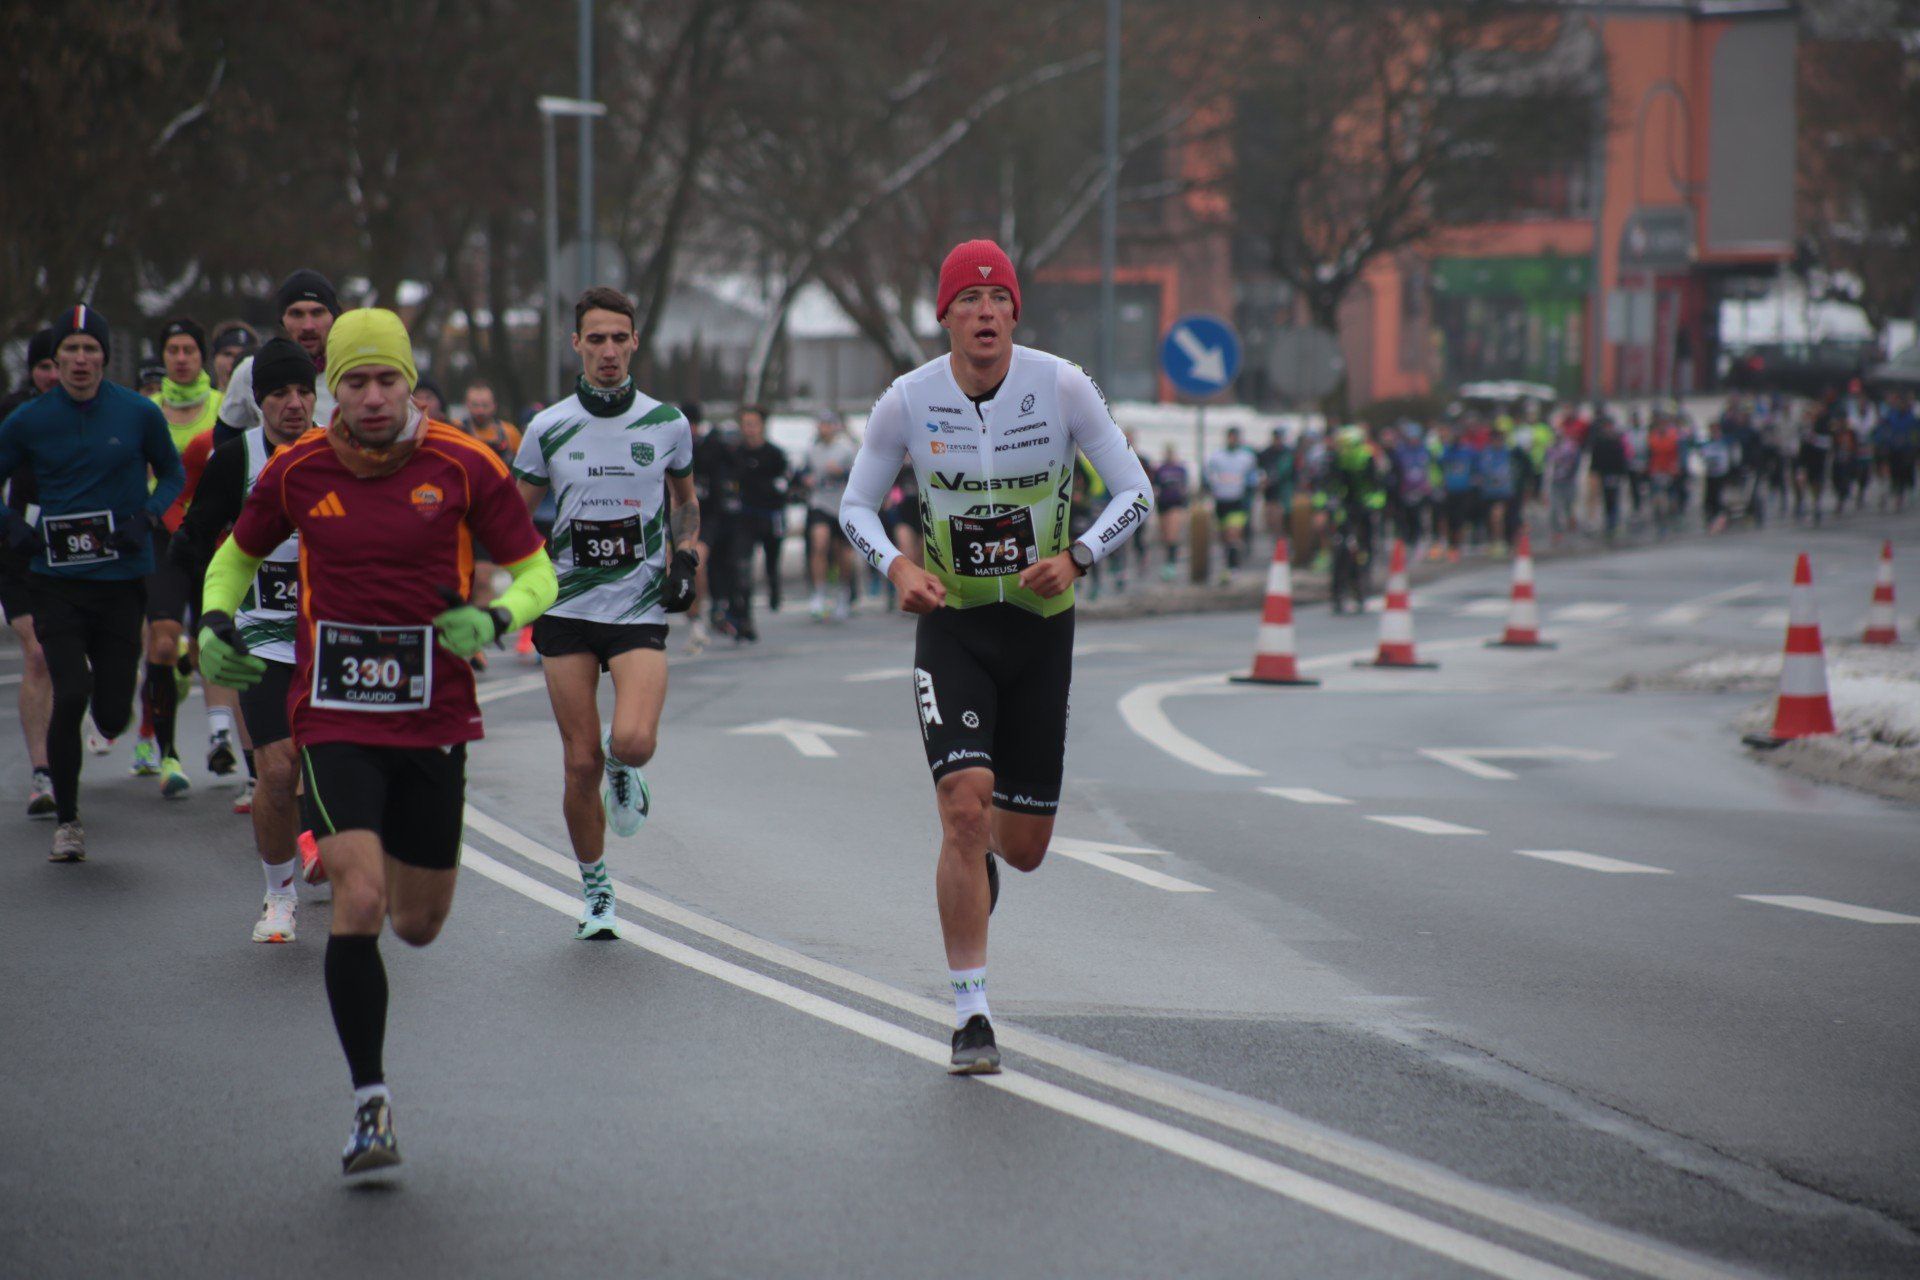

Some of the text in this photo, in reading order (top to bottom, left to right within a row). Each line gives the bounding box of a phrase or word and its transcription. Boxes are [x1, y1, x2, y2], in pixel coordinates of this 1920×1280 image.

[1003, 421, 1047, 436] ORBEA
[994, 436, 1050, 452] NO-LIMITED
[933, 470, 1050, 491] VOSTER
[582, 498, 622, 507] KAPRYS
[1052, 472, 1071, 555] VOST
[1098, 500, 1150, 545] VOSTER
[67, 533, 93, 553] 96
[587, 537, 626, 558] 391
[845, 520, 879, 567] VOSTER
[969, 537, 1019, 565] 375
[600, 559, 620, 567] FILIP
[974, 564, 1019, 576] MATEUSZ
[273, 581, 298, 600] 24
[341, 657, 401, 688] 330
[345, 690, 397, 702] CLAUDIO
